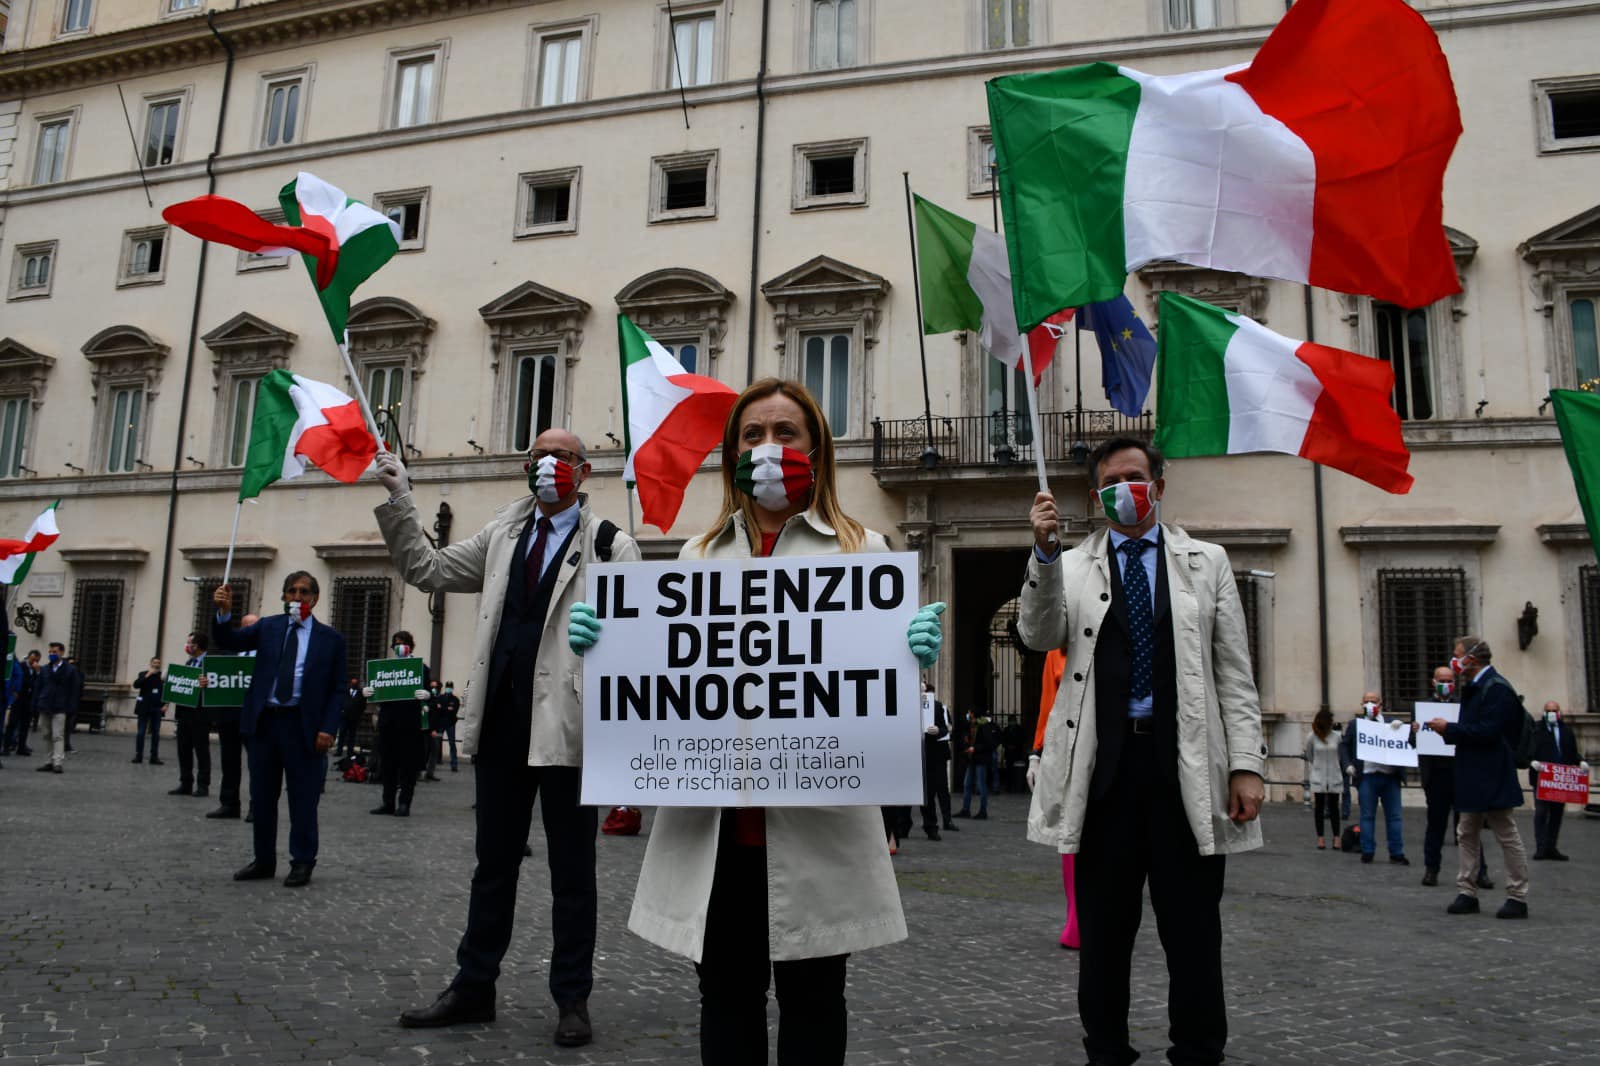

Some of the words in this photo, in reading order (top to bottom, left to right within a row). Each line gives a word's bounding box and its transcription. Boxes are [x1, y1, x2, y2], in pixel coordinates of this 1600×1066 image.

[597, 575, 639, 619] IL
[656, 564, 905, 617] SILENZIO
[668, 618, 823, 669] DEGLI
[206, 671, 252, 689] Baris
[600, 668, 898, 721] INNOCENTI
[653, 735, 670, 751] In
[677, 733, 840, 755] rappresentanza
[1358, 732, 1410, 750] Balnear
[630, 753, 677, 771] delle
[685, 752, 762, 775] migliaia
[769, 752, 788, 771] di
[796, 751, 865, 770] italiani
[634, 773, 670, 790] che
[677, 772, 770, 791] rischiano
[778, 772, 787, 790] il
[795, 772, 861, 790] lavoro
